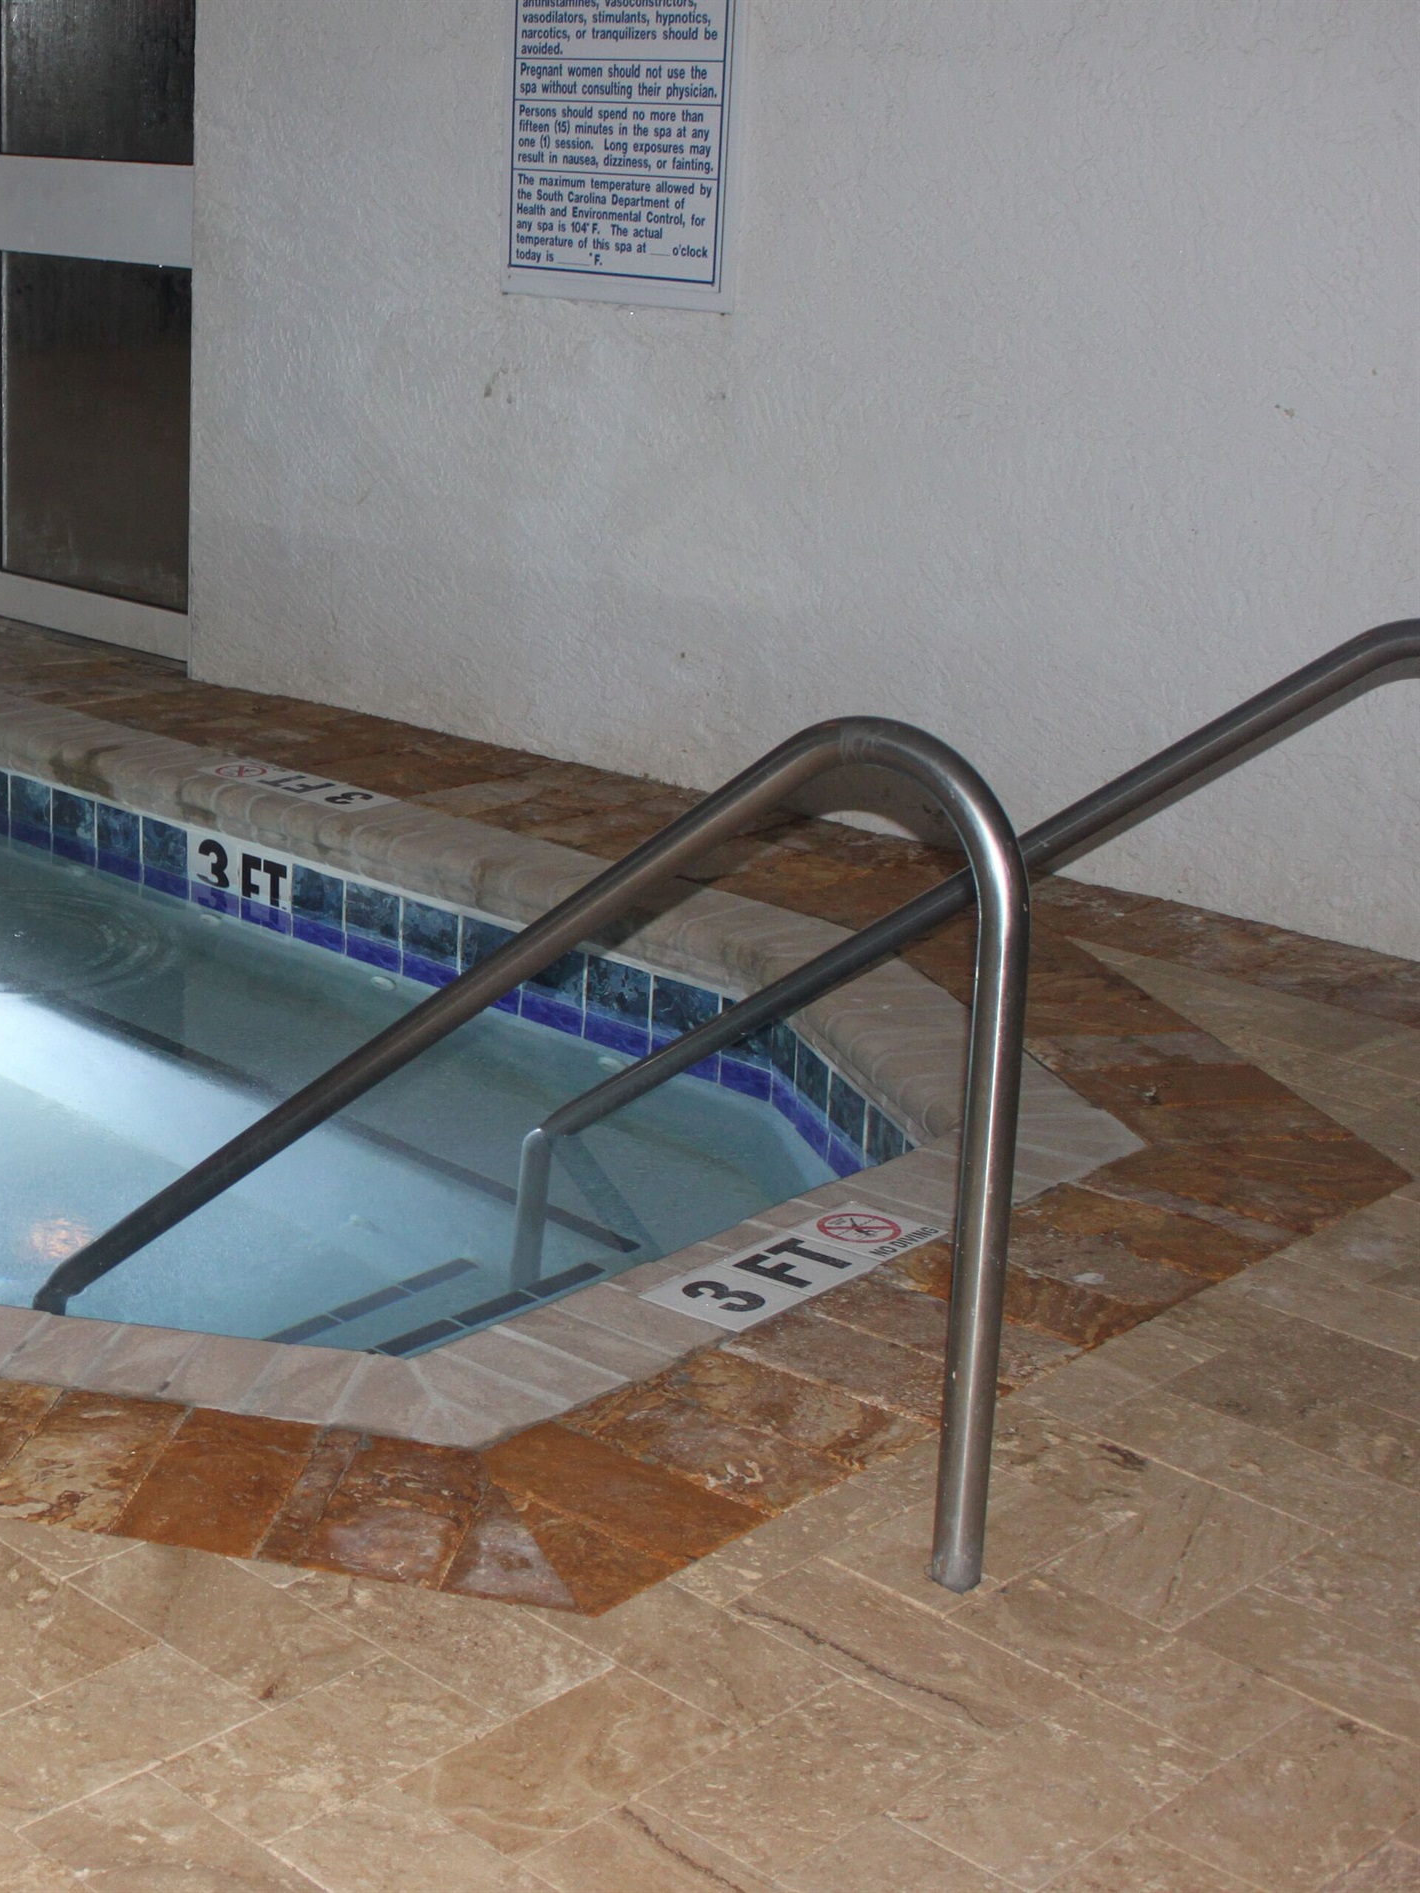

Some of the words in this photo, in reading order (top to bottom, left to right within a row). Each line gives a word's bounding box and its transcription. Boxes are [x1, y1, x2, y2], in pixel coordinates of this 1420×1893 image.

[522, 11, 587, 25] vasodilators,
[592, 11, 650, 26] stimulants,
[656, 11, 711, 26] hypnotics,
[522, 27, 570, 42] narcotics,
[576, 29, 586, 40] or
[592, 27, 656, 42] tranquilizers
[663, 28, 698, 40] should
[705, 28, 717, 40] be
[522, 43, 563, 55] avoided.
[520, 63, 563, 79] Pregnant
[568, 66, 602, 77] women
[608, 64, 640, 78] should
[646, 66, 662, 79] not
[668, 68, 685, 79] use
[691, 66, 707, 79] the
[520, 83, 536, 96] spa
[542, 81, 577, 94] without
[582, 83, 632, 98] consulting
[638, 83, 661, 97] their
[666, 84, 717, 100] physician.
[519, 104, 556, 118] Persons
[562, 106, 593, 118] should
[598, 107, 627, 119] spend
[633, 108, 644, 121] no
[650, 110, 676, 122] more
[682, 108, 703, 122] than
[519, 122, 549, 133] fifteen
[554, 121, 570, 135] (15)
[575, 123, 613, 135] minutes
[619, 123, 628, 136] in
[633, 124, 648, 136] the
[654, 126, 671, 140] spa
[677, 125, 686, 138] at
[692, 128, 710, 141] any
[518, 138, 535, 147] one
[540, 135, 550, 148] (1)
[555, 138, 594, 149] session.
[604, 138, 627, 154] Long
[633, 142, 684, 154] exposures
[690, 145, 711, 157] may
[518, 151, 544, 163] result
[549, 152, 557, 163] in
[562, 155, 598, 168] nausea,
[604, 154, 651, 171] dizziness,
[657, 159, 667, 169] or
[672, 157, 713, 174] fainting.
[518, 174, 534, 186] The
[540, 176, 585, 188] maximum
[591, 178, 650, 193] temperature
[656, 180, 694, 195] allowed
[700, 182, 712, 198] by
[518, 189, 531, 200] the
[537, 189, 563, 202] South
[568, 192, 606, 204] Carolina
[612, 194, 669, 209] Department
[675, 197, 685, 209] of
[517, 203, 545, 216] Health
[550, 206, 567, 217] and
[572, 206, 641, 222] Environmental
[647, 212, 686, 227] Control,
[691, 214, 705, 226] for
[517, 220, 532, 232] any
[537, 222, 553, 232] spa
[558, 220, 566, 232] is
[611, 224, 628, 236] The
[633, 226, 663, 238] actual
[516, 233, 573, 247] temperature
[578, 237, 587, 248] of
[593, 238, 610, 250] this
[615, 242, 632, 253] spa
[637, 242, 646, 253] at
[672, 245, 708, 258] o'clock
[516, 249, 541, 263] today
[546, 250, 554, 261] is
[257, 775, 336, 794] FT
[324, 792, 373, 804] 3
[197, 839, 230, 888] 3
[869, 1246, 898, 1258] NO
[892, 1226, 940, 1248] DIVING
[682, 1280, 766, 1312] 3
[732, 1238, 852, 1289] FT
